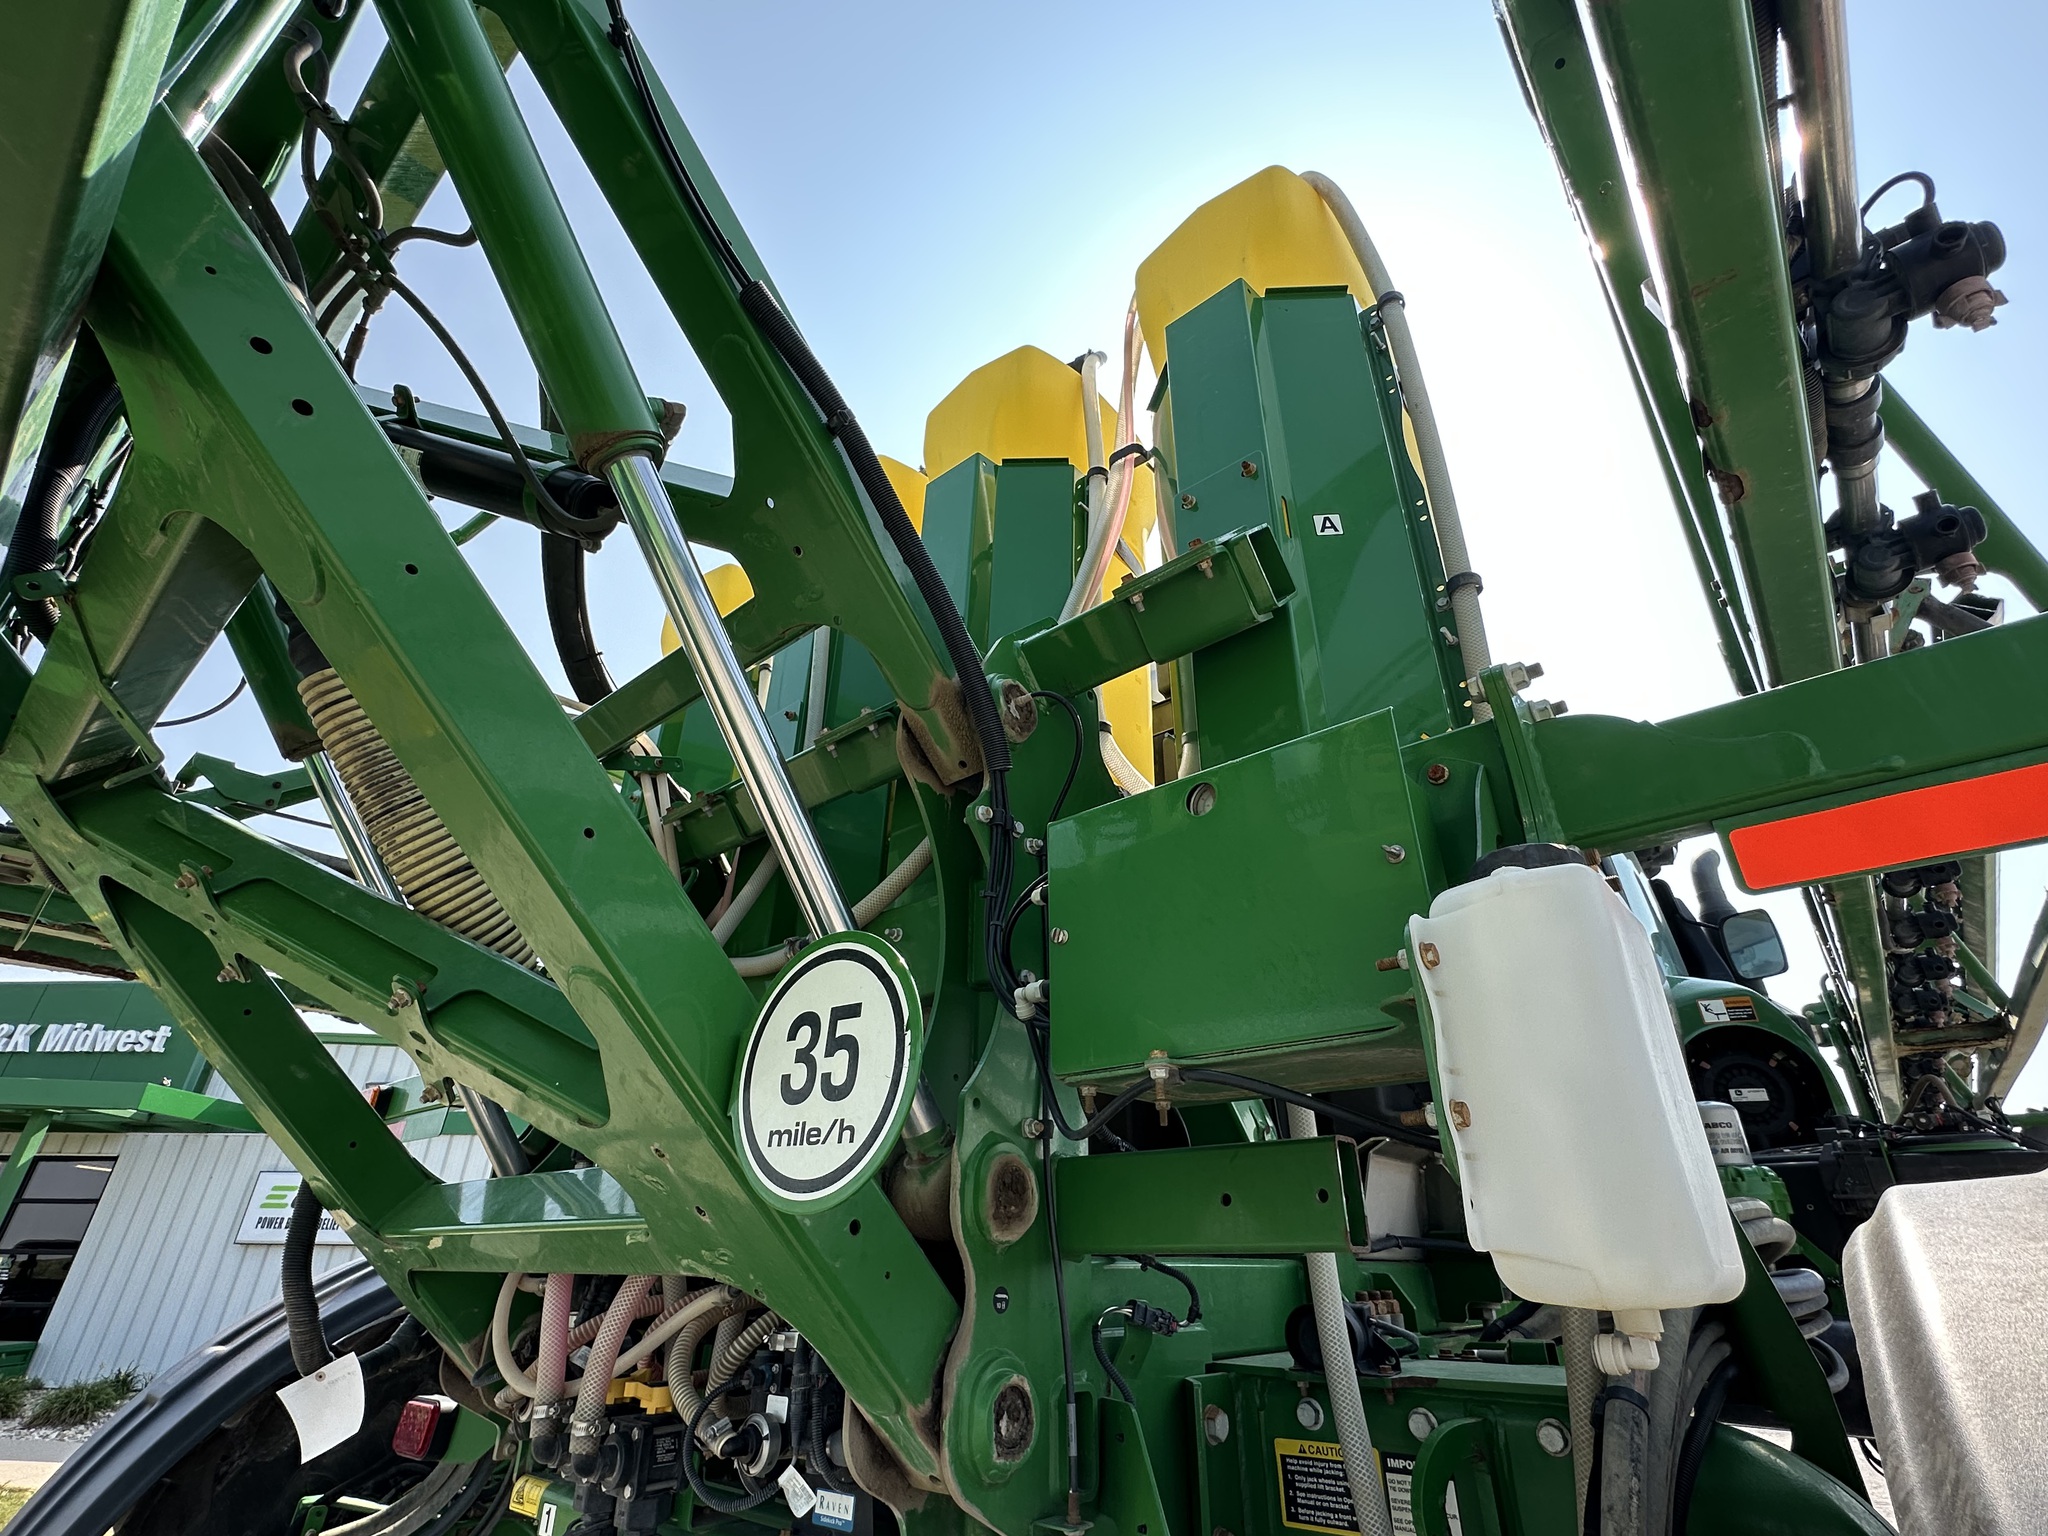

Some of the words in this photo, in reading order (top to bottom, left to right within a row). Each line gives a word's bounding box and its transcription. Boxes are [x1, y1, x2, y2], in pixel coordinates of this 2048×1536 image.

[1320, 516, 1339, 532] A
[36, 1022, 172, 1053] Midwest
[780, 1002, 864, 1106] 35
[767, 1118, 856, 1148] mile/h
[255, 1216, 285, 1229] POWER
[1308, 1444, 1343, 1458] CAUTIO
[1386, 1458, 1415, 1470] IMPO
[819, 1495, 849, 1515] RAVEN
[546, 1507, 552, 1533] 1
